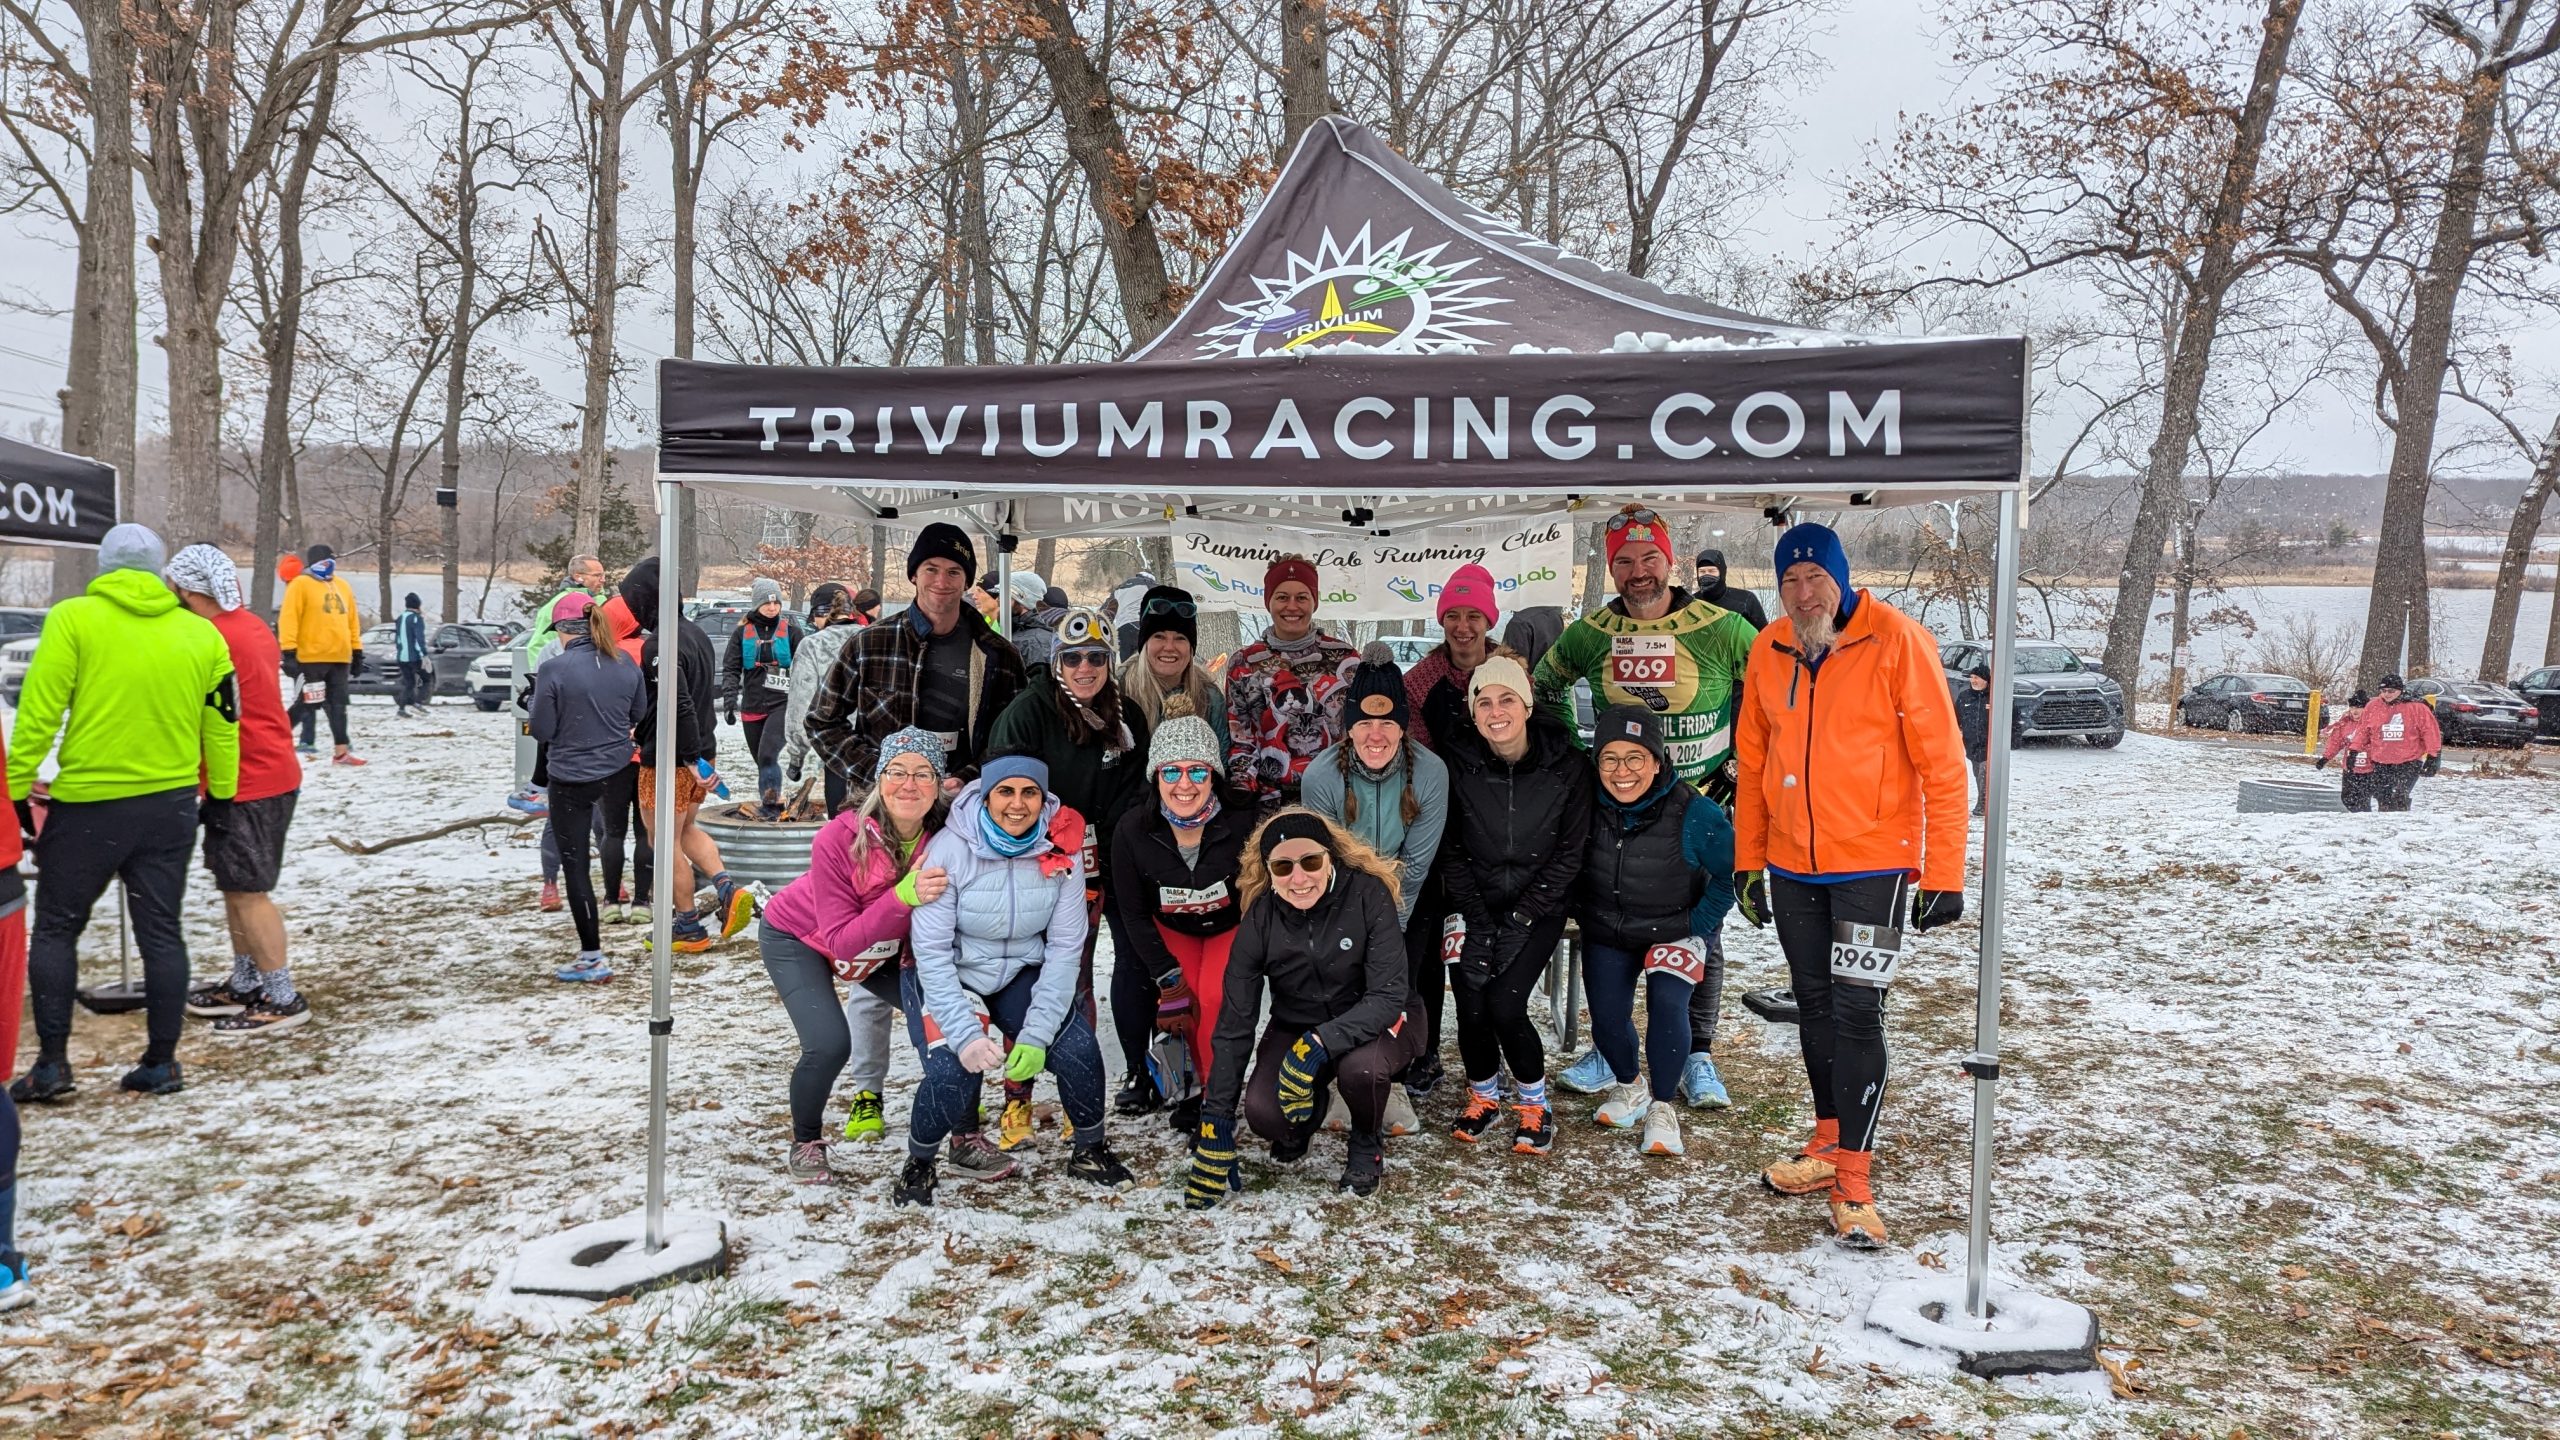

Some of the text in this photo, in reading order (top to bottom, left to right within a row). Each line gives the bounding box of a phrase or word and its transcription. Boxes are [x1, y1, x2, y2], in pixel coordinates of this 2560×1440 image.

[1283, 308, 1383, 340] TRIVIUM
[748, 389, 1903, 460] TRIVIUMRACING.COM
[1186, 523, 1561, 567] Runnin Lab Running Club
[1618, 658, 1667, 679] 969
[1678, 710, 1721, 736] FRIDAY
[1677, 742, 1703, 764] 2024
[1676, 764, 1706, 779] RATHON
[1652, 947, 1699, 973] 967
[1833, 946, 1895, 973] 2967
